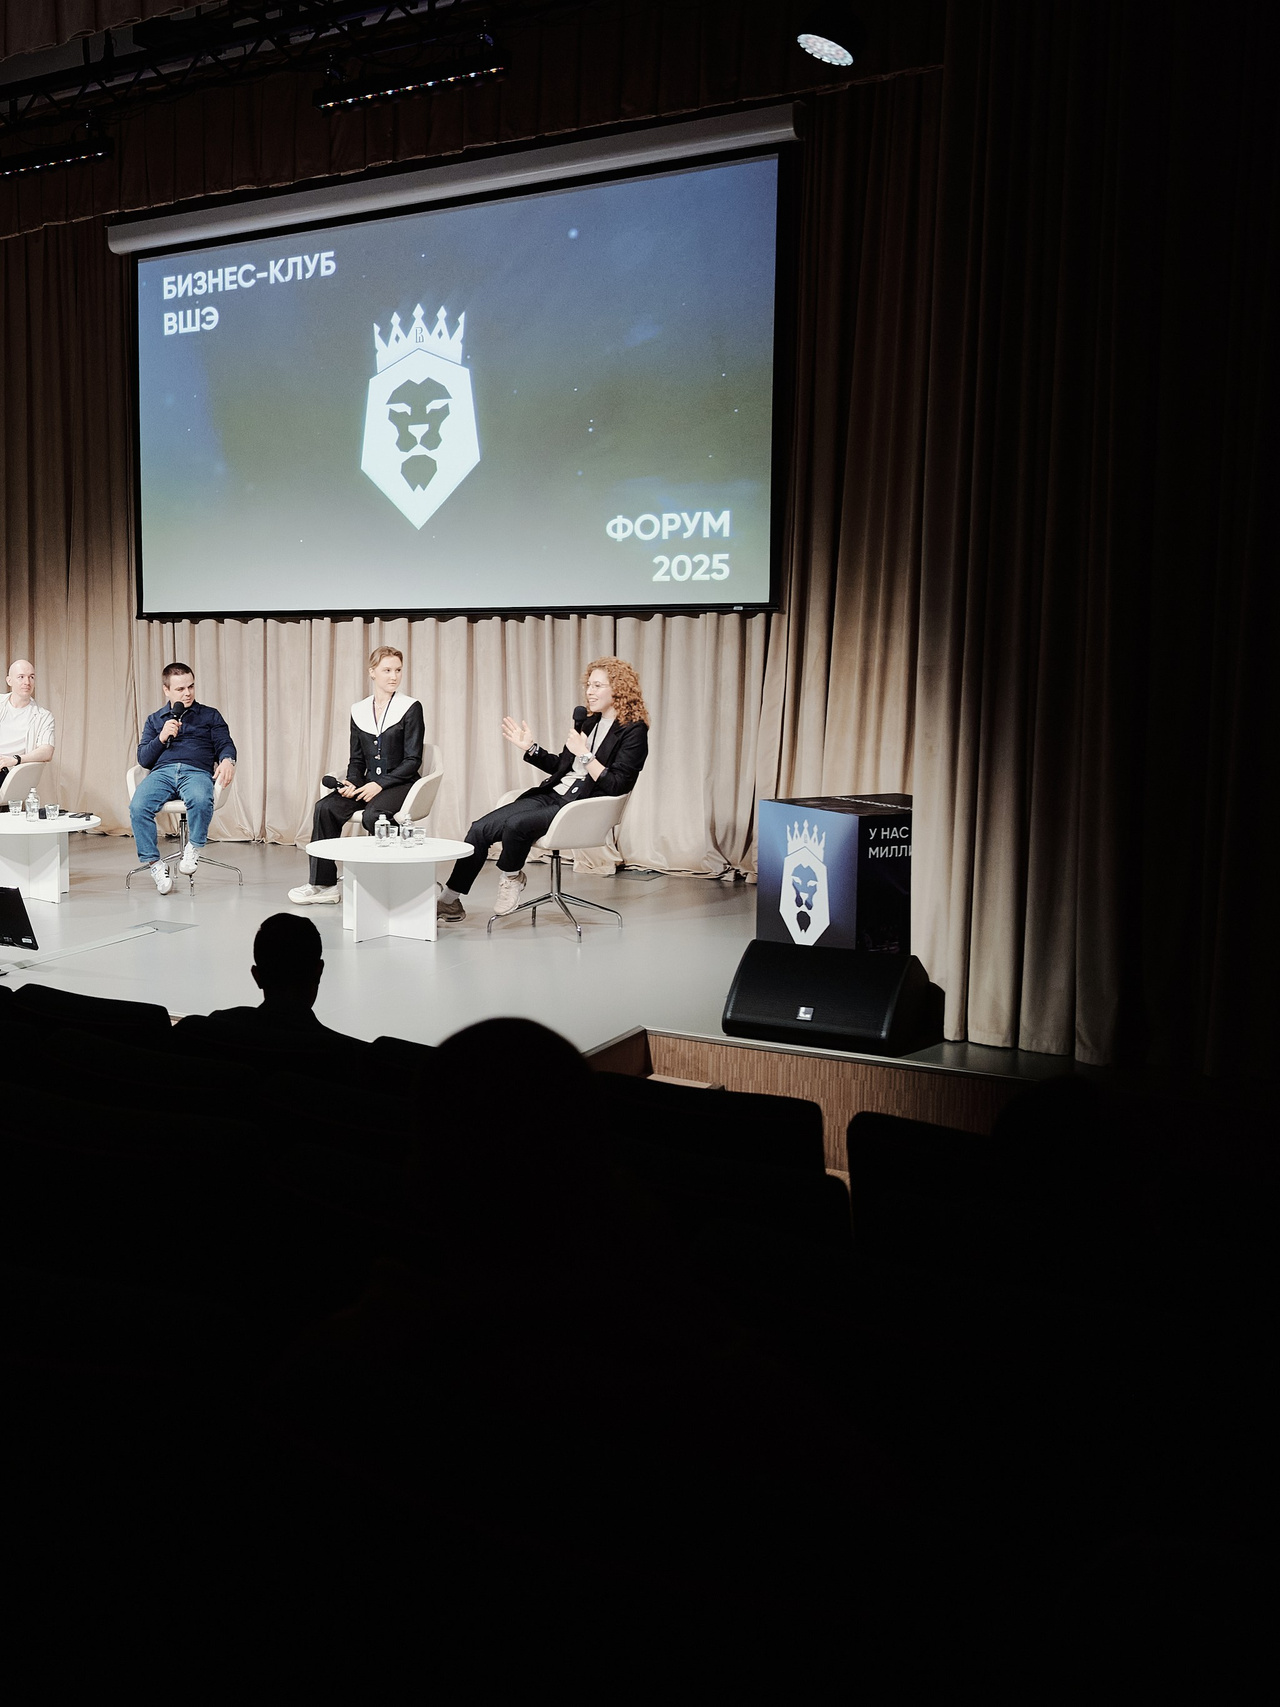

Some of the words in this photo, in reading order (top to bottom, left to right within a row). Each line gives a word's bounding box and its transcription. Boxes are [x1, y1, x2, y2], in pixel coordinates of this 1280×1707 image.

[163, 251, 337, 300] БИЗНЕС-КЛУБ
[163, 306, 220, 336] ВШЭ
[606, 510, 730, 542] ФОРУМ
[652, 553, 730, 582] 2025
[869, 828, 877, 840] У
[881, 826, 909, 839] НАС
